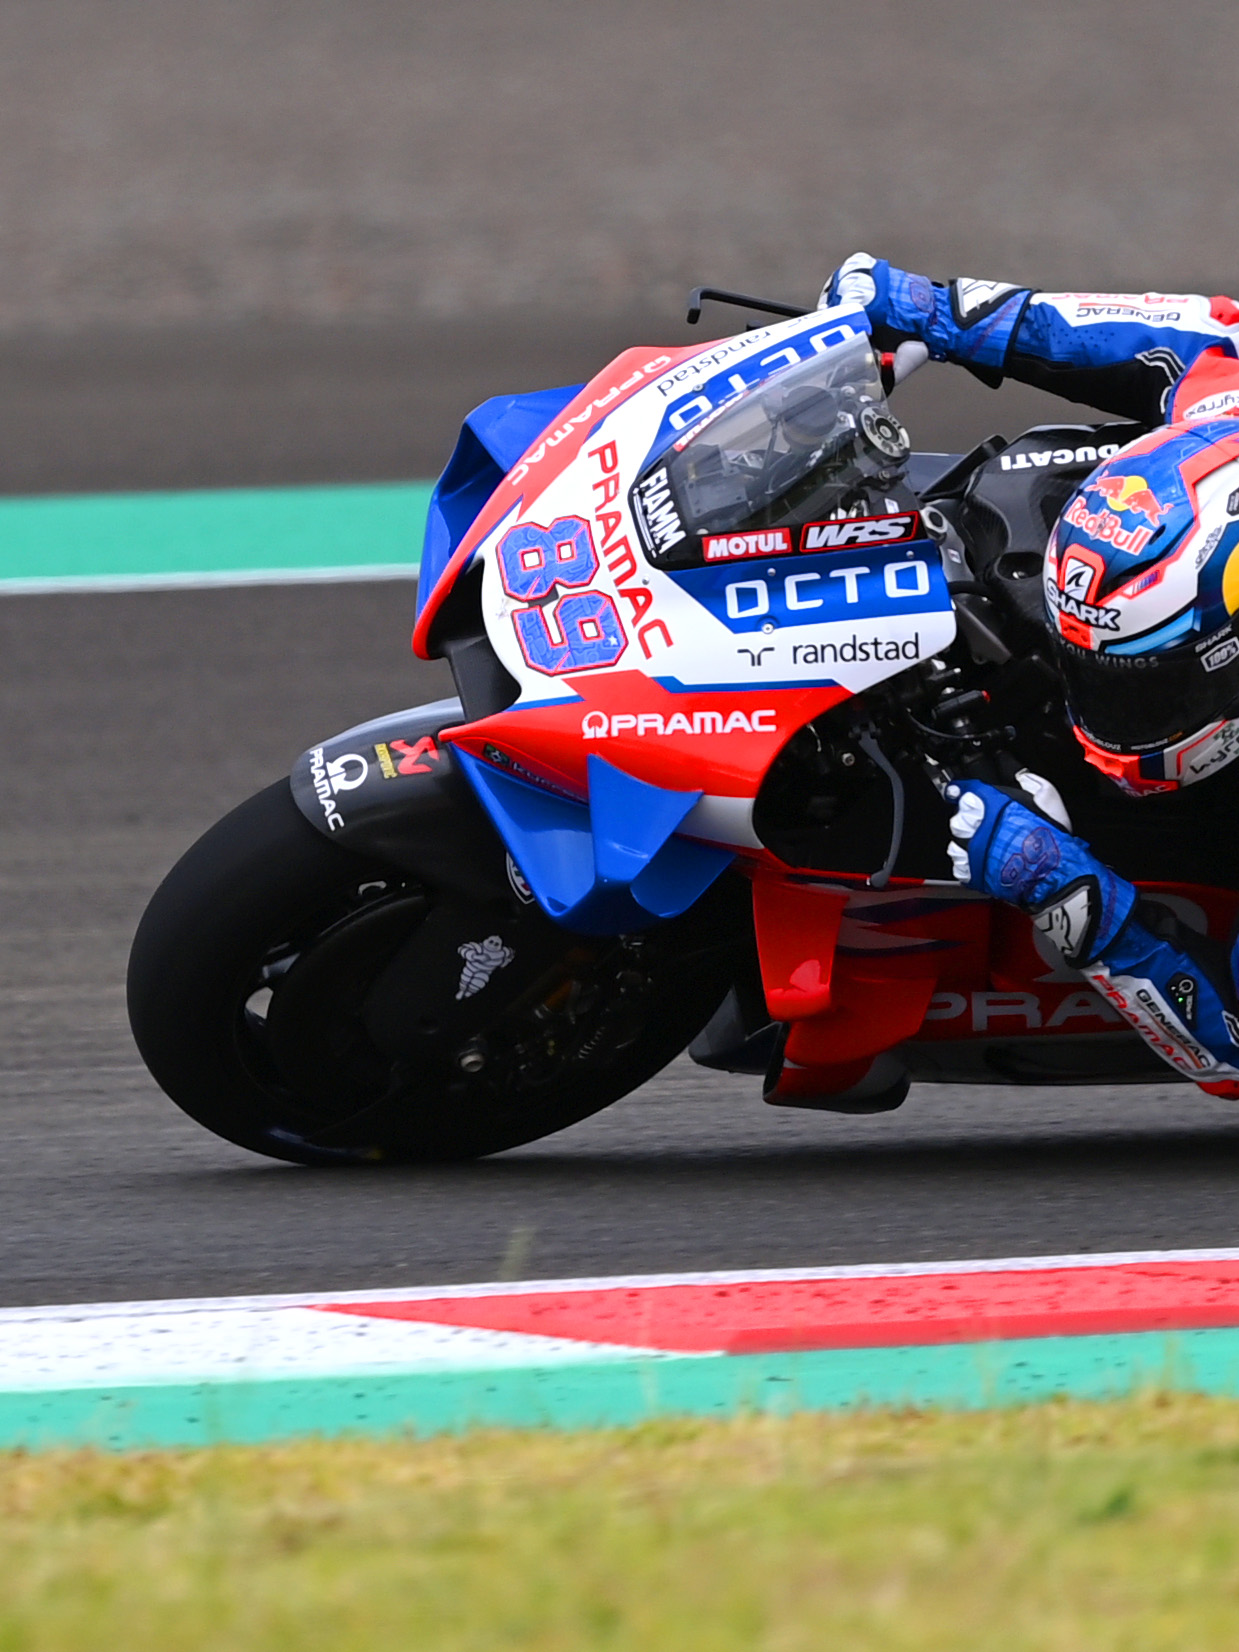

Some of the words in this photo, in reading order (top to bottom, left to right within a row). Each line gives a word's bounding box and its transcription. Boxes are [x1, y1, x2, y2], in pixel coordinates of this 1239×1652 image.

[1076, 306, 1181, 322] GENERAC
[657, 331, 770, 397] randstad
[506, 366, 645, 486] PRAMAC
[1000, 444, 1120, 471] DUCATI
[639, 467, 686, 554] FIAMM
[805, 514, 910, 549] WRS
[1064, 496, 1107, 538] Red
[1102, 514, 1153, 555] Bull
[588, 441, 674, 659] PRAMAC
[707, 532, 788, 558] MOTUL
[496, 515, 629, 676] 89
[725, 560, 930, 619] OCTO
[1046, 580, 1121, 632] SHARK
[792, 633, 919, 665] randstad
[1095, 653, 1159, 669] WINGS
[1206, 641, 1238, 668] 100%
[611, 710, 776, 736] PRAMAC
[309, 748, 344, 832] PRAMAC
[1092, 975, 1192, 1070] PRAMAC
[1136, 989, 1211, 1068] GENERAC
